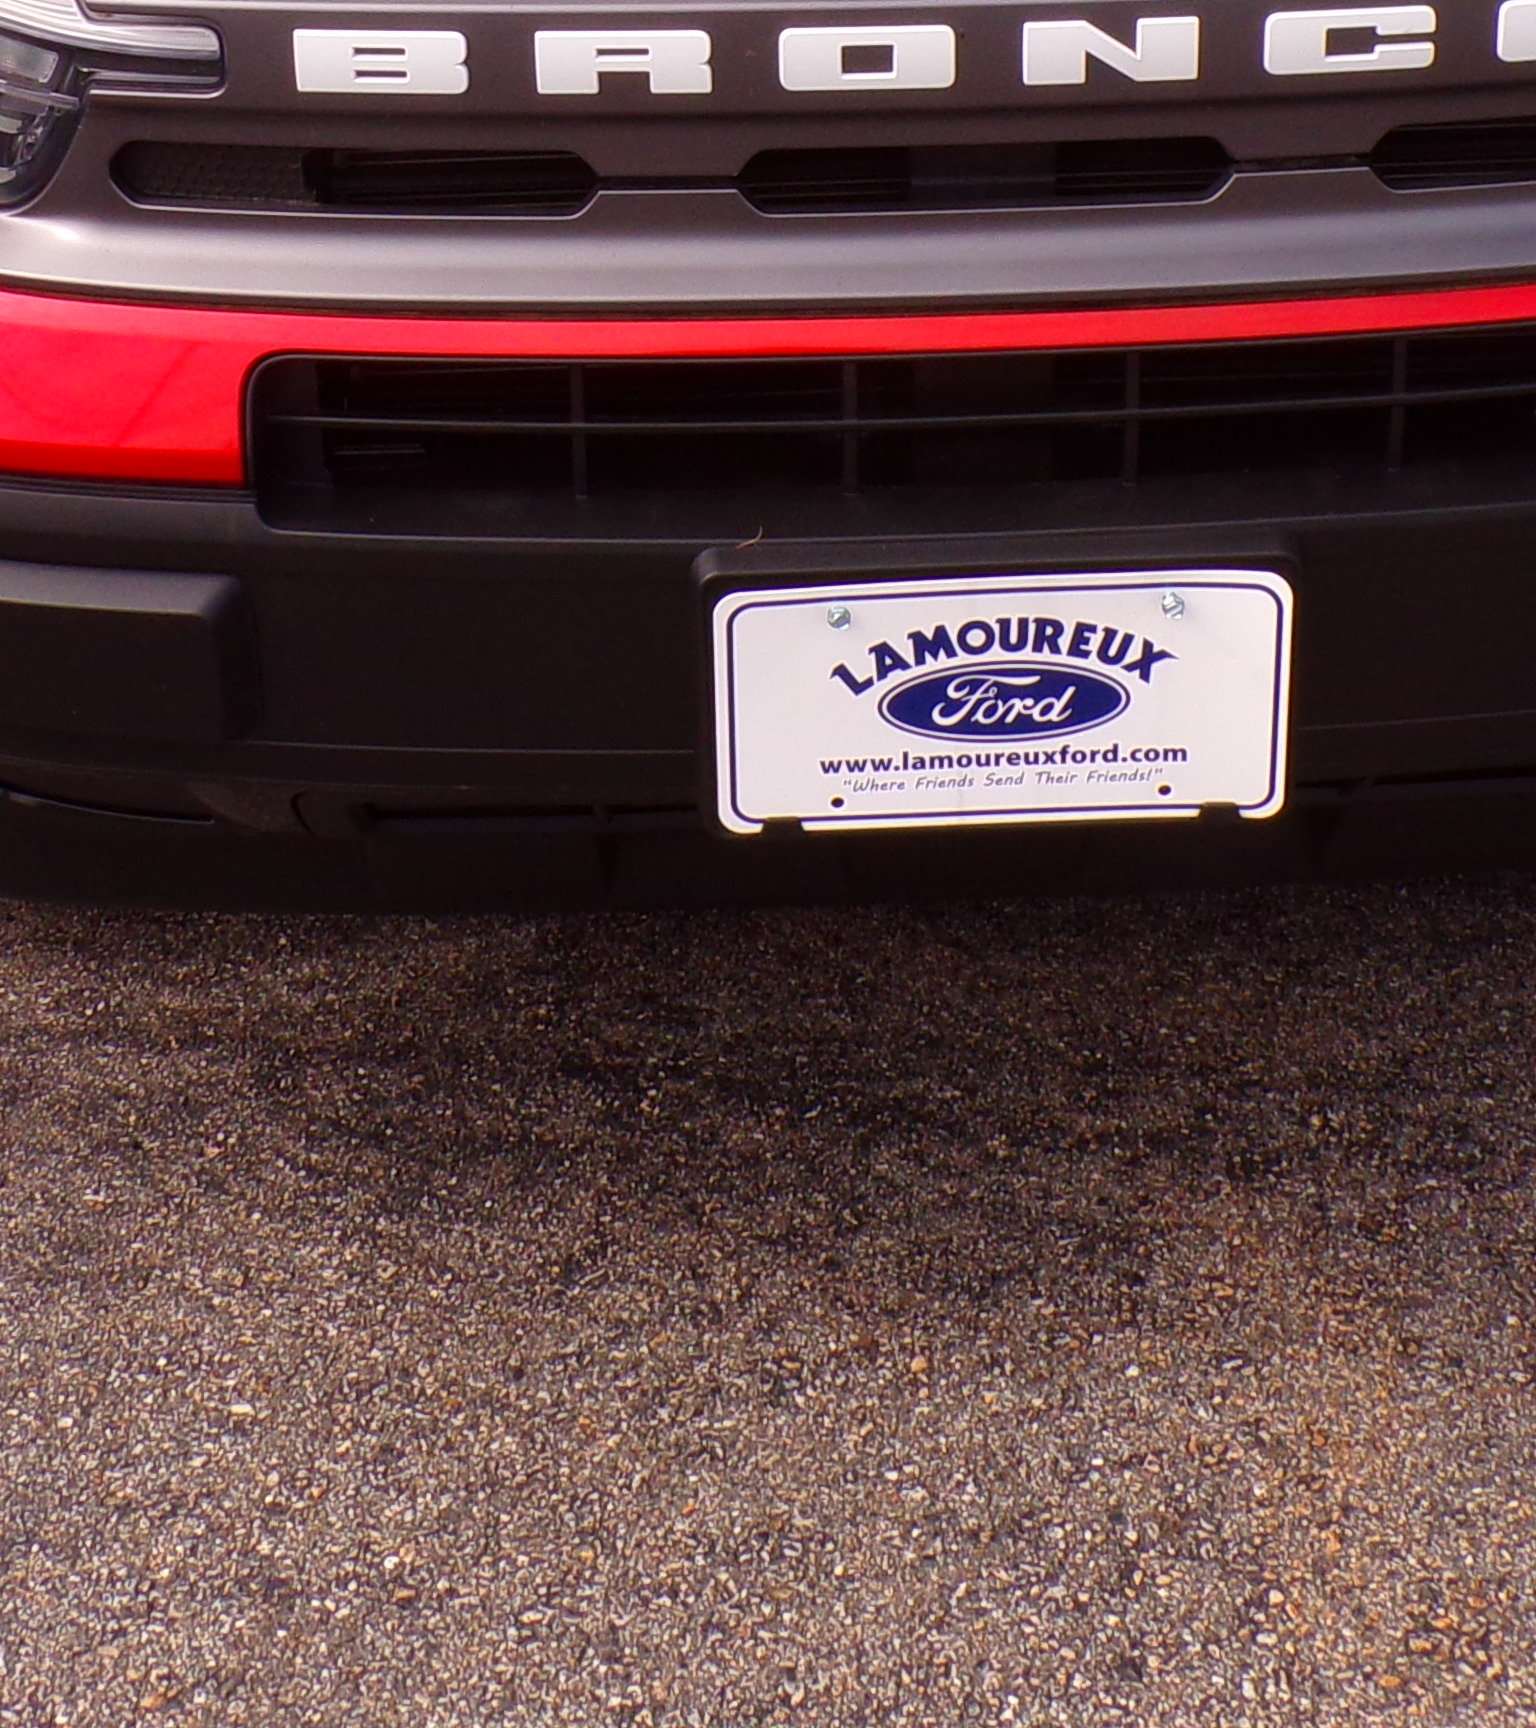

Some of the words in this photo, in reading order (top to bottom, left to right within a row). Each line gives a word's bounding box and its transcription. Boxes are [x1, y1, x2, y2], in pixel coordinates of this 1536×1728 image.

[830, 617, 1180, 697] LAMOUREUX
[931, 674, 1076, 726] Ford
[819, 743, 1188, 774] www.lamoureuxford.com
[915, 773, 975, 790] Friends
[984, 771, 1024, 786] Send
[1034, 770, 1078, 786] Their
